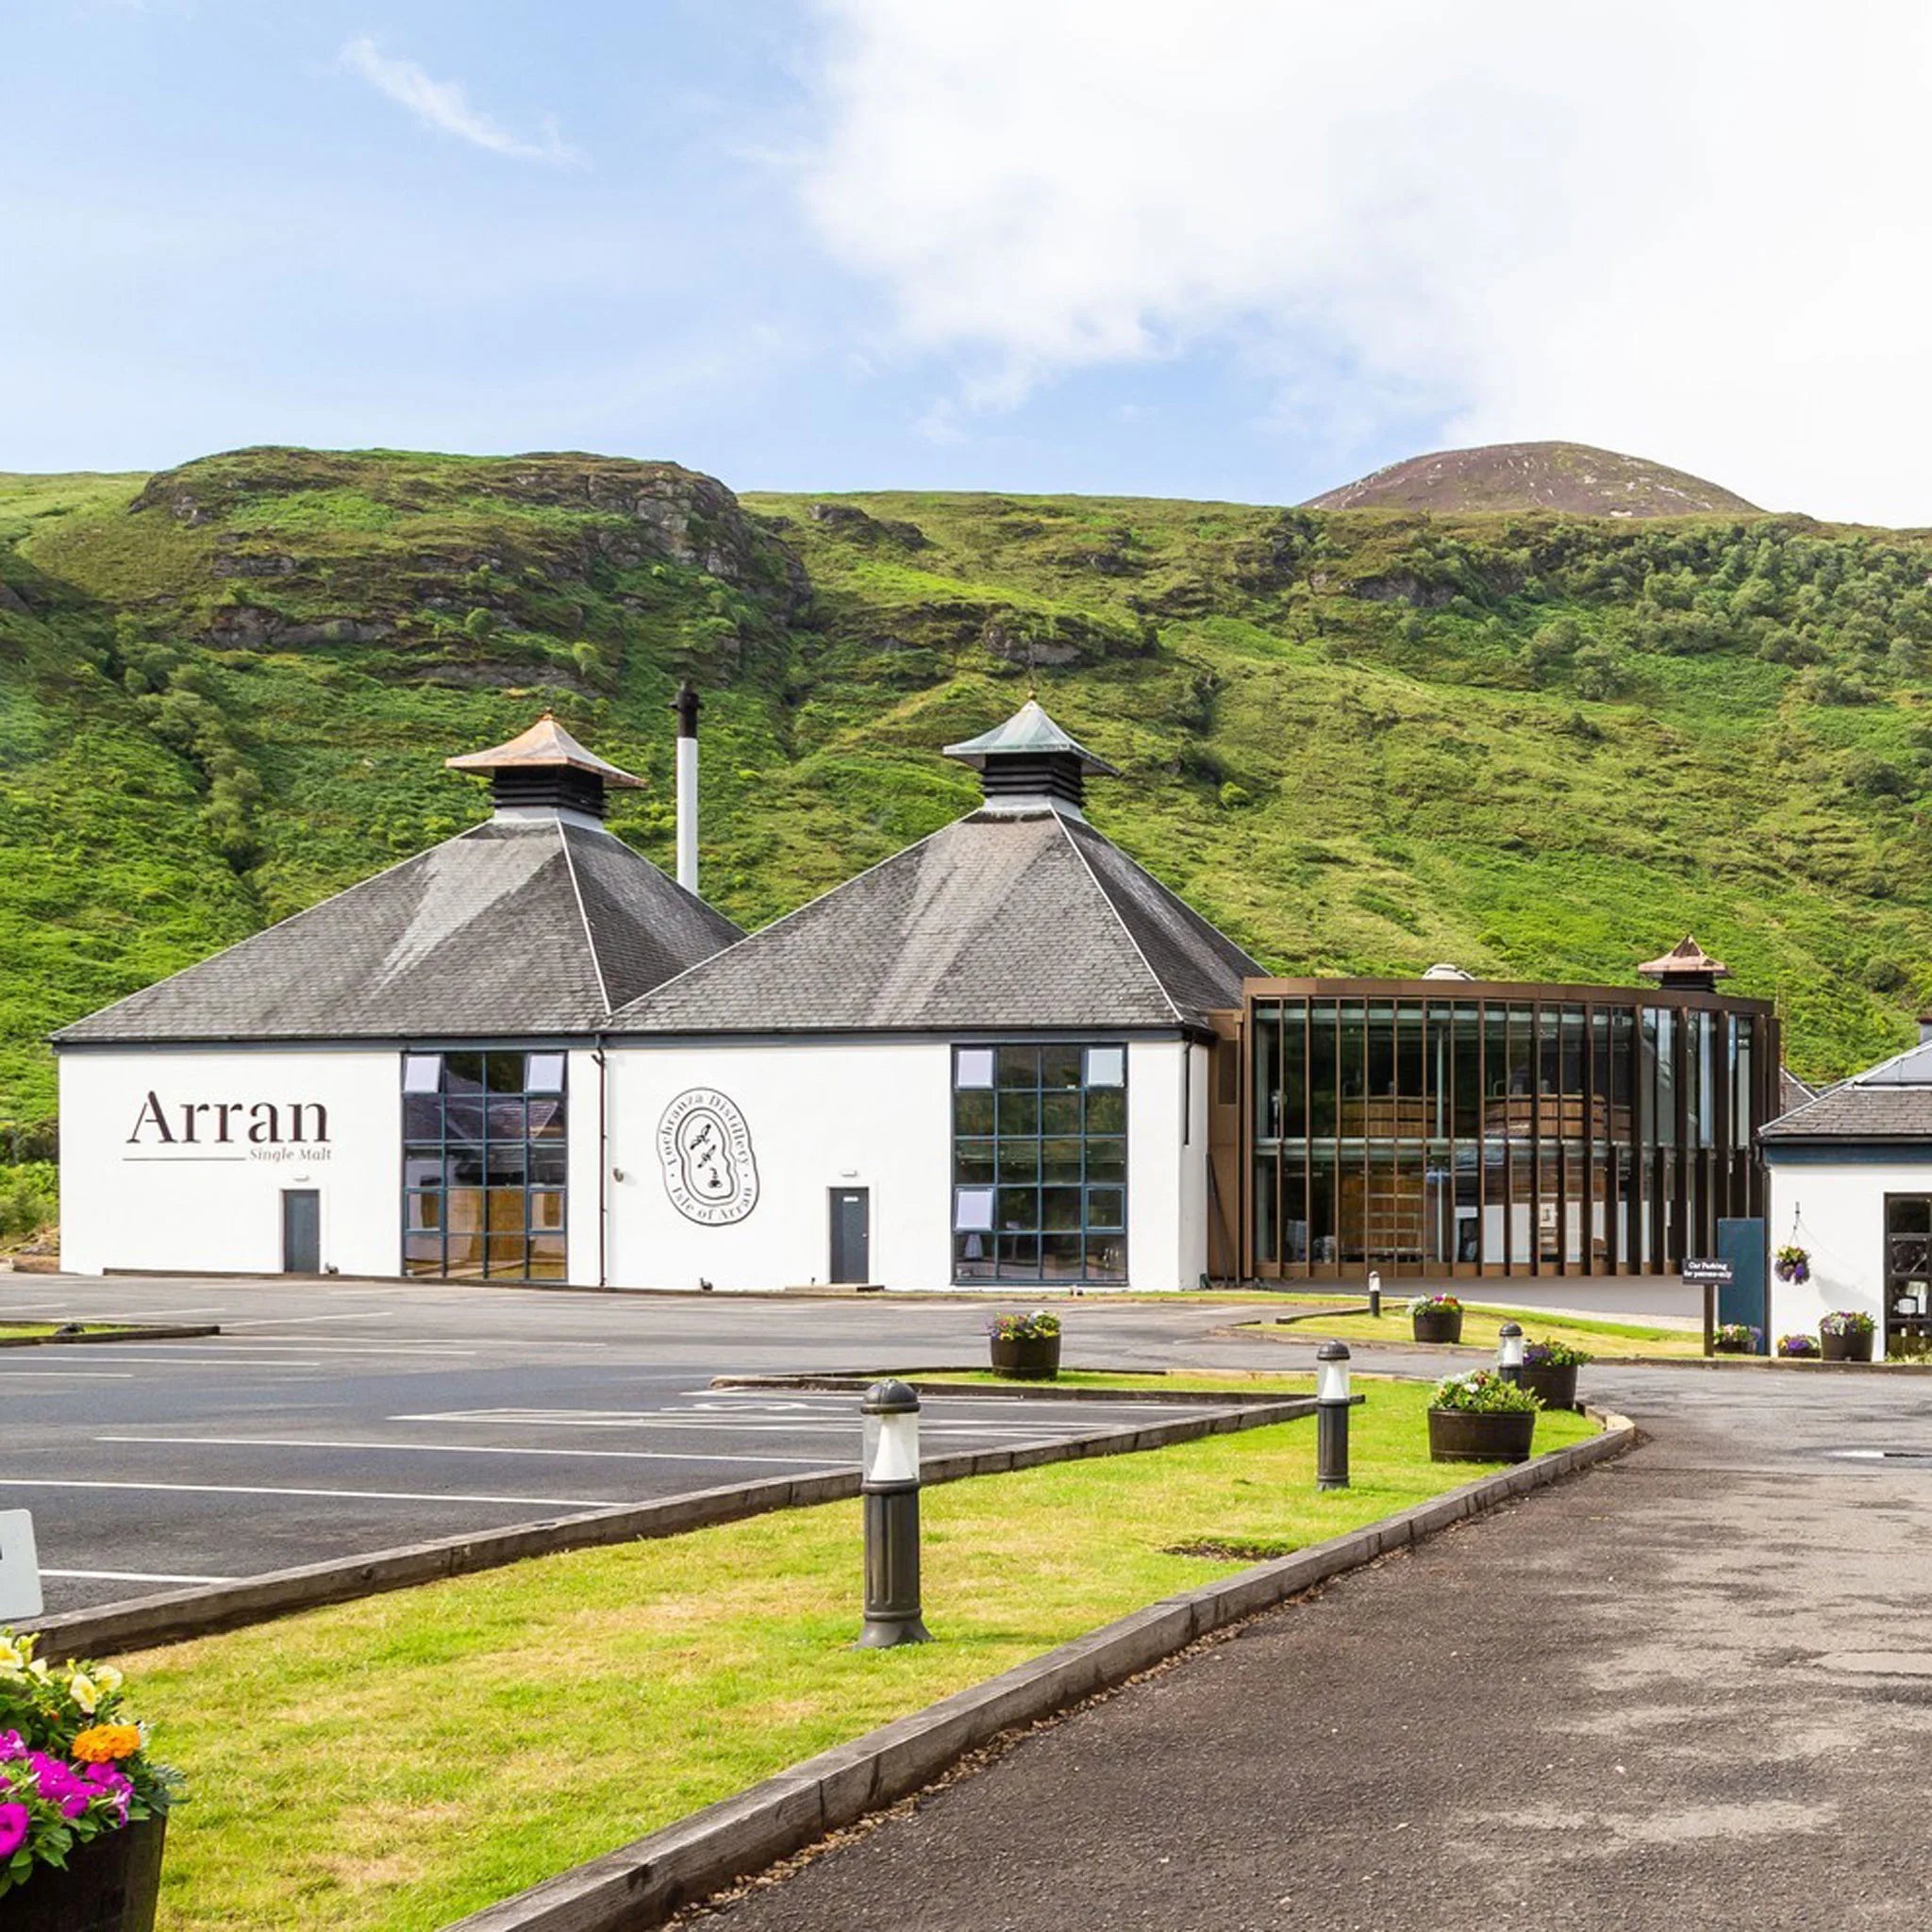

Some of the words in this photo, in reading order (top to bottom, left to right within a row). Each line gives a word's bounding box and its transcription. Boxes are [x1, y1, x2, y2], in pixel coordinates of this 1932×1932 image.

[125, 1091, 332, 1143] Arran
[661, 1094, 704, 1166] Lochranza
[708, 1094, 750, 1165] Distillery
[249, 1148, 295, 1162] Single
[299, 1148, 332, 1160] Malt
[671, 1187, 695, 1211] Isle
[696, 1208, 714, 1221] of
[717, 1187, 753, 1221] Arran
